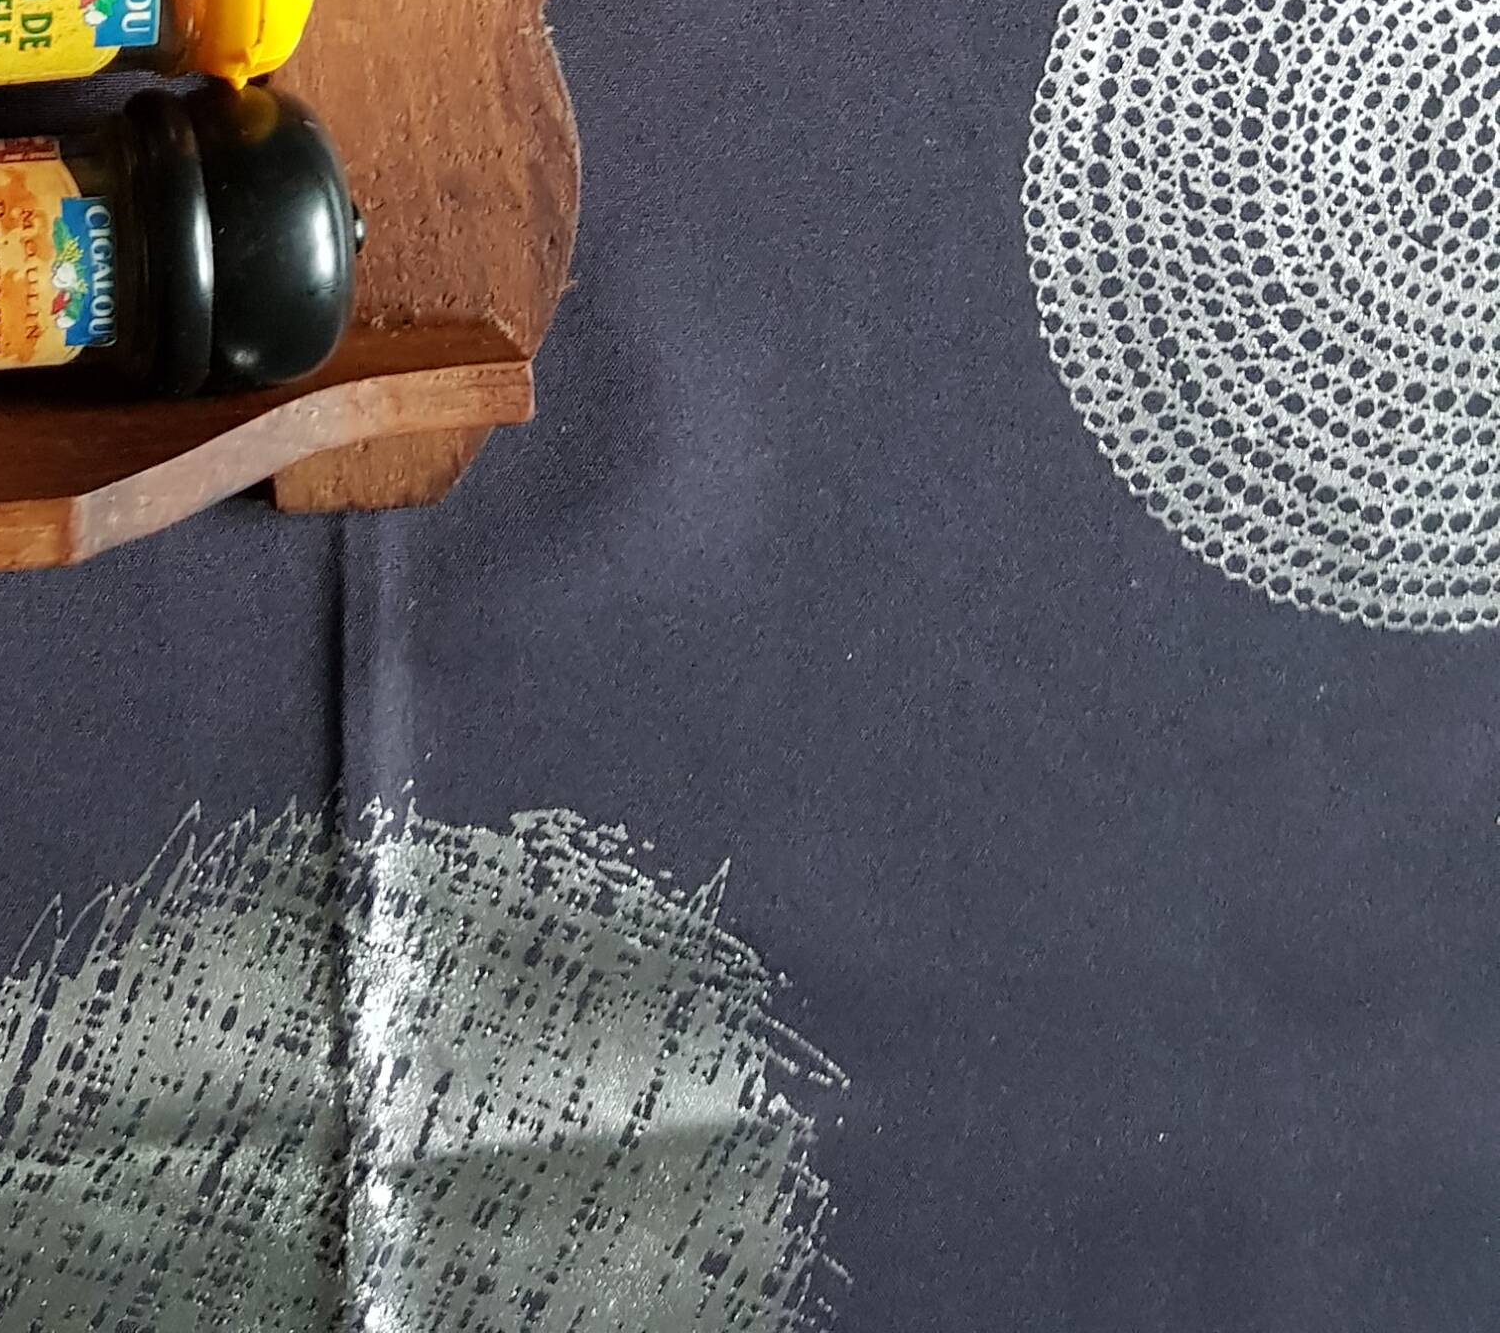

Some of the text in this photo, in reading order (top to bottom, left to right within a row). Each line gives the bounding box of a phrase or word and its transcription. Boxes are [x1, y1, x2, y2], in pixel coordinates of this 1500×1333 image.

[18, 13, 53, 51] DE
[19, 209, 42, 340] MOULIN
[84, 204, 115, 337] CIGALOU
